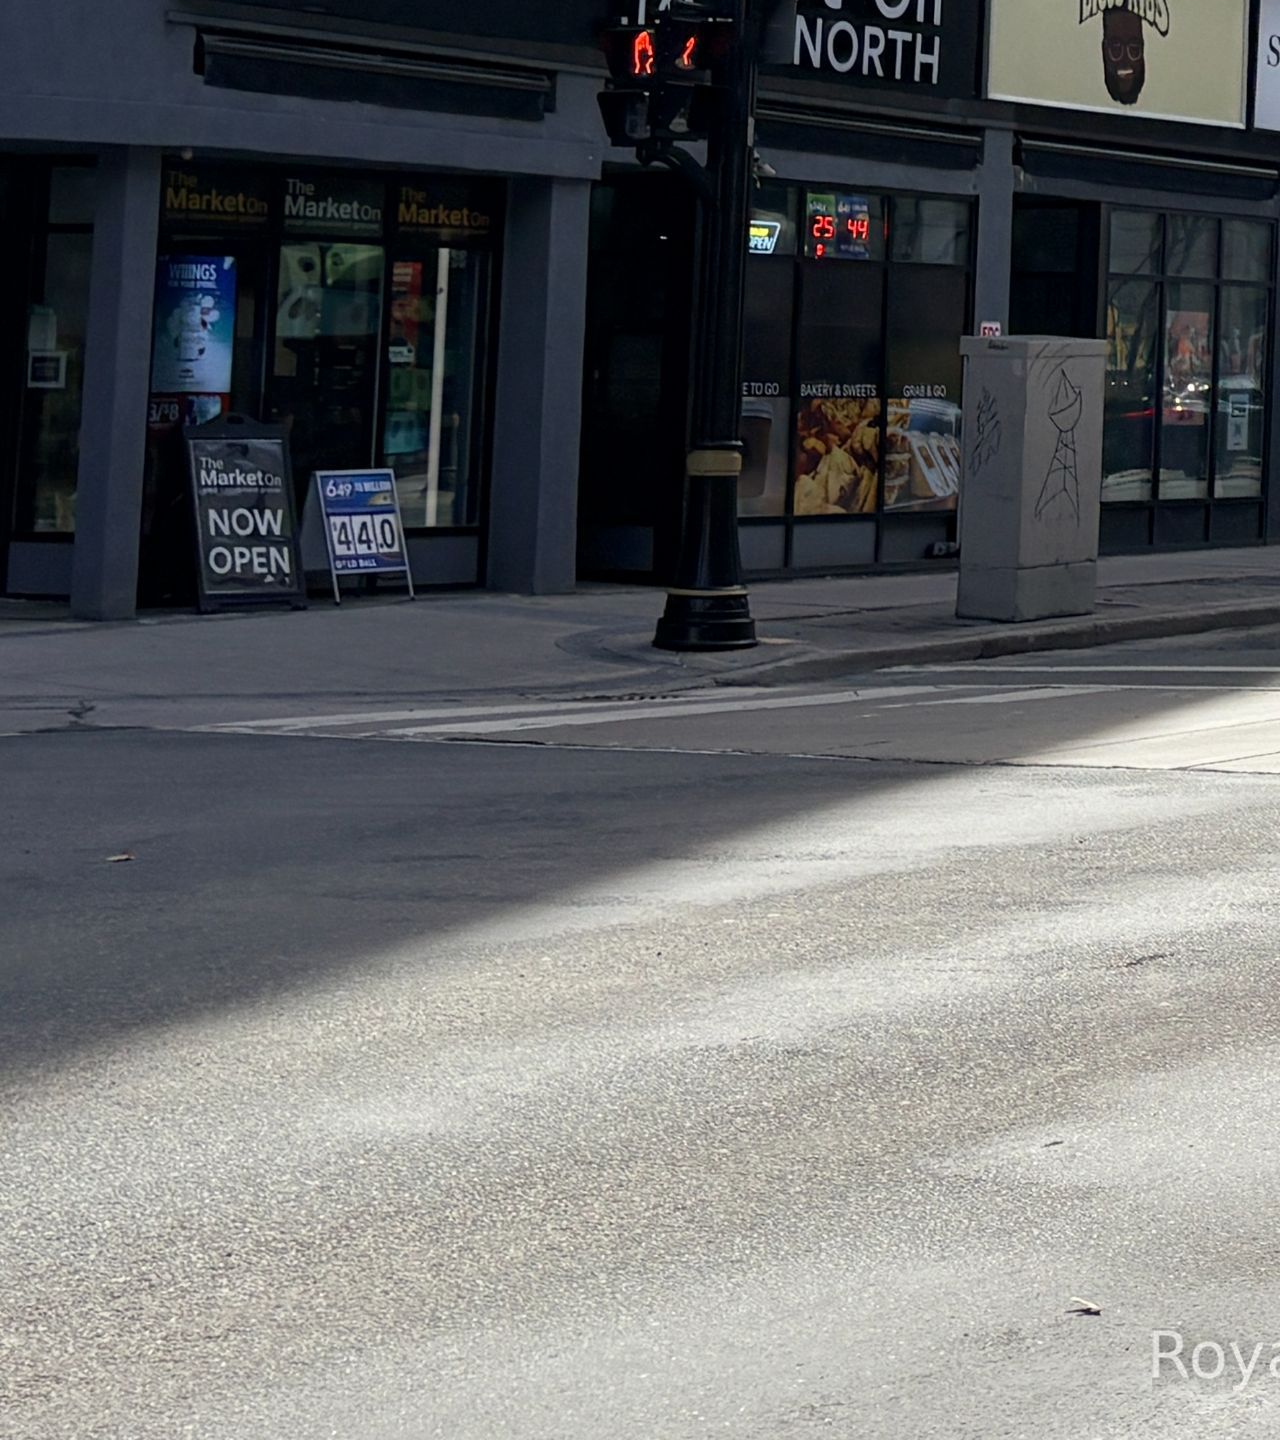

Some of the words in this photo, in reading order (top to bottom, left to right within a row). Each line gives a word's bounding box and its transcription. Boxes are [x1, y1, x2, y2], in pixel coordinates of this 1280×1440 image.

[793, 14, 941, 85] NORTH
[286, 178, 317, 197] The
[748, 236, 774, 251] PEN
[750, 382, 764, 396] TO
[764, 382, 781, 396] GO
[800, 383, 834, 398] BAKERY
[834, 384, 842, 397] &
[842, 383, 878, 398] SWEETS
[199, 456, 224, 471] The
[207, 507, 284, 537] NOW
[208, 545, 291, 576] OPEN
